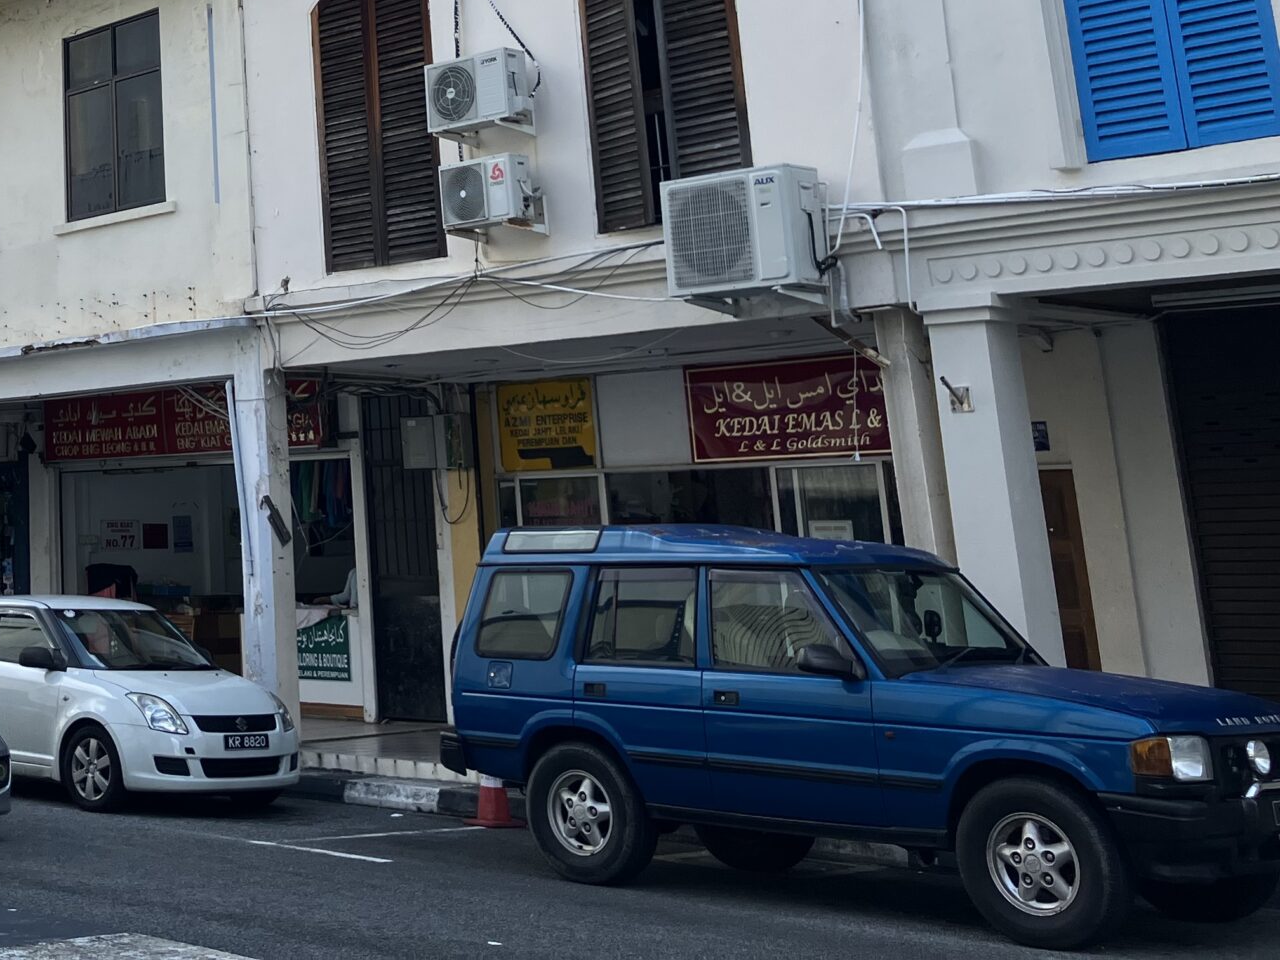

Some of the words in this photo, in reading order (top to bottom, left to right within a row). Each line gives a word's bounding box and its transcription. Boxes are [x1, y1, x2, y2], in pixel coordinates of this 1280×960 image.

[753, 176, 775, 186] AUX
[536, 412, 589, 426] ENTERPRISE
[715, 414, 780, 438] KEDAI
[785, 410, 844, 435] EMAS
[867, 407, 882, 428] &
[53, 429, 82, 445] KEDAI
[85, 427, 122, 442] MEWAH
[125, 423, 158, 439] ABADI
[175, 420, 204, 436] KEDAI
[510, 428, 530, 437] KEDAI
[517, 438, 560, 447] PEREMPUAN
[562, 436, 577, 445] DAN
[738, 440, 749, 453] L
[753, 440, 766, 451] &
[770, 438, 781, 450] L
[786, 433, 872, 452] Goldsmith
[55, 444, 80, 457] CHOP
[82, 443, 100, 456] ENG
[102, 441, 131, 455] LEONG
[323, 653, 348, 668] BOUTIQUE
[317, 670, 349, 679] PEREMPUAN
[1215, 716, 1251, 727] LAND
[228, 735, 241, 748] KR
[243, 735, 266, 748] 8820
